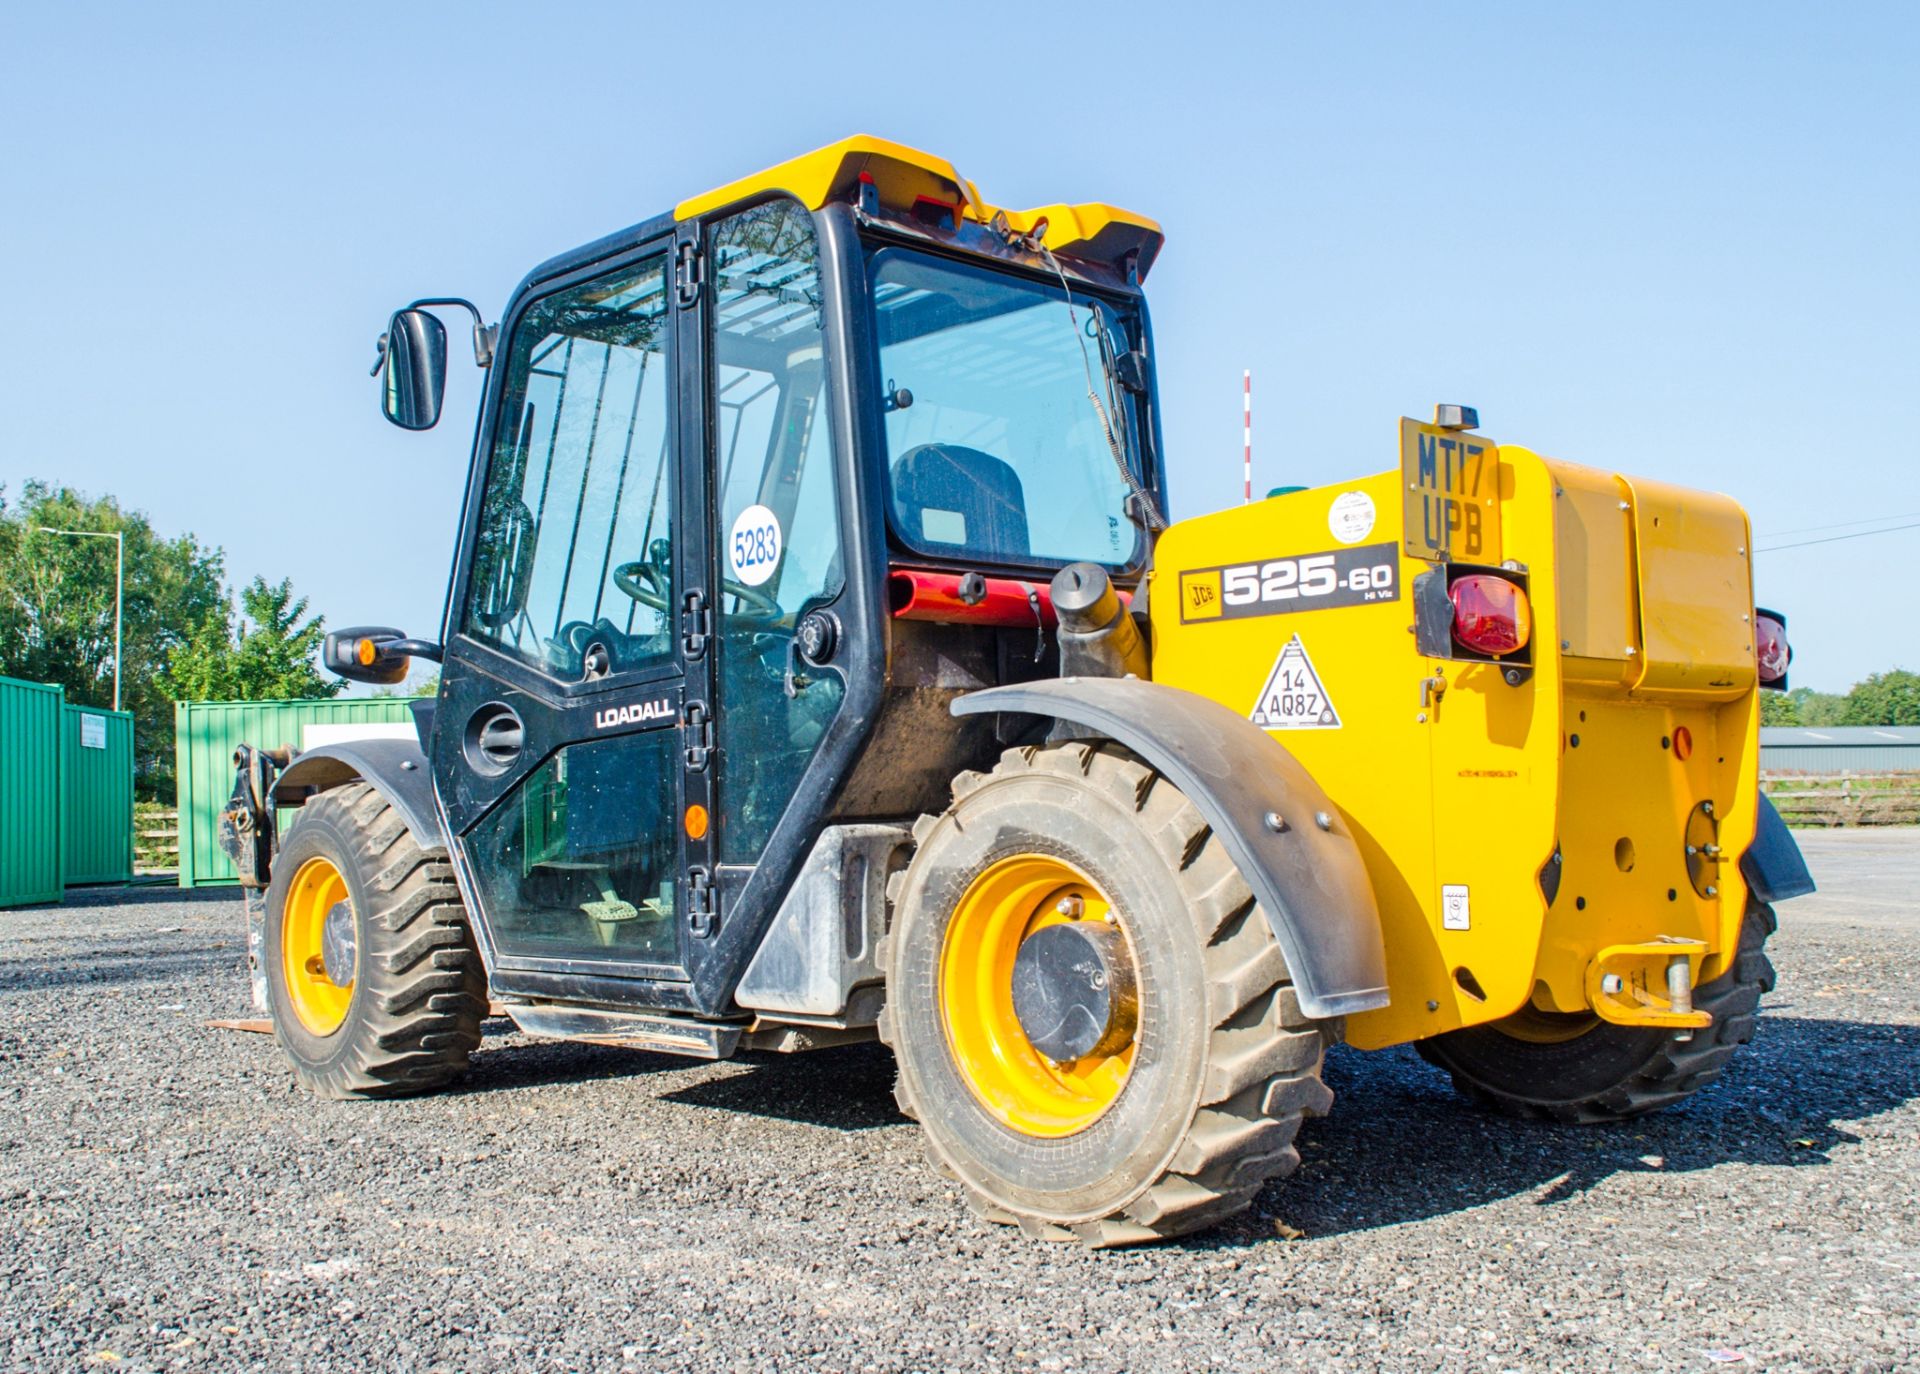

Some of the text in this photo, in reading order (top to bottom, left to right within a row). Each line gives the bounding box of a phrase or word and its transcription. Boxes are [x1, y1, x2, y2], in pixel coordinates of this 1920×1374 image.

[1418, 432, 1484, 497] MT17
[1423, 494, 1482, 556] UPB
[735, 525, 776, 568] 5283
[1192, 585, 1214, 606] JCB
[1282, 668, 1304, 691] 14
[596, 699, 675, 729] LOADALL
[1269, 694, 1318, 717] AQ8Z
